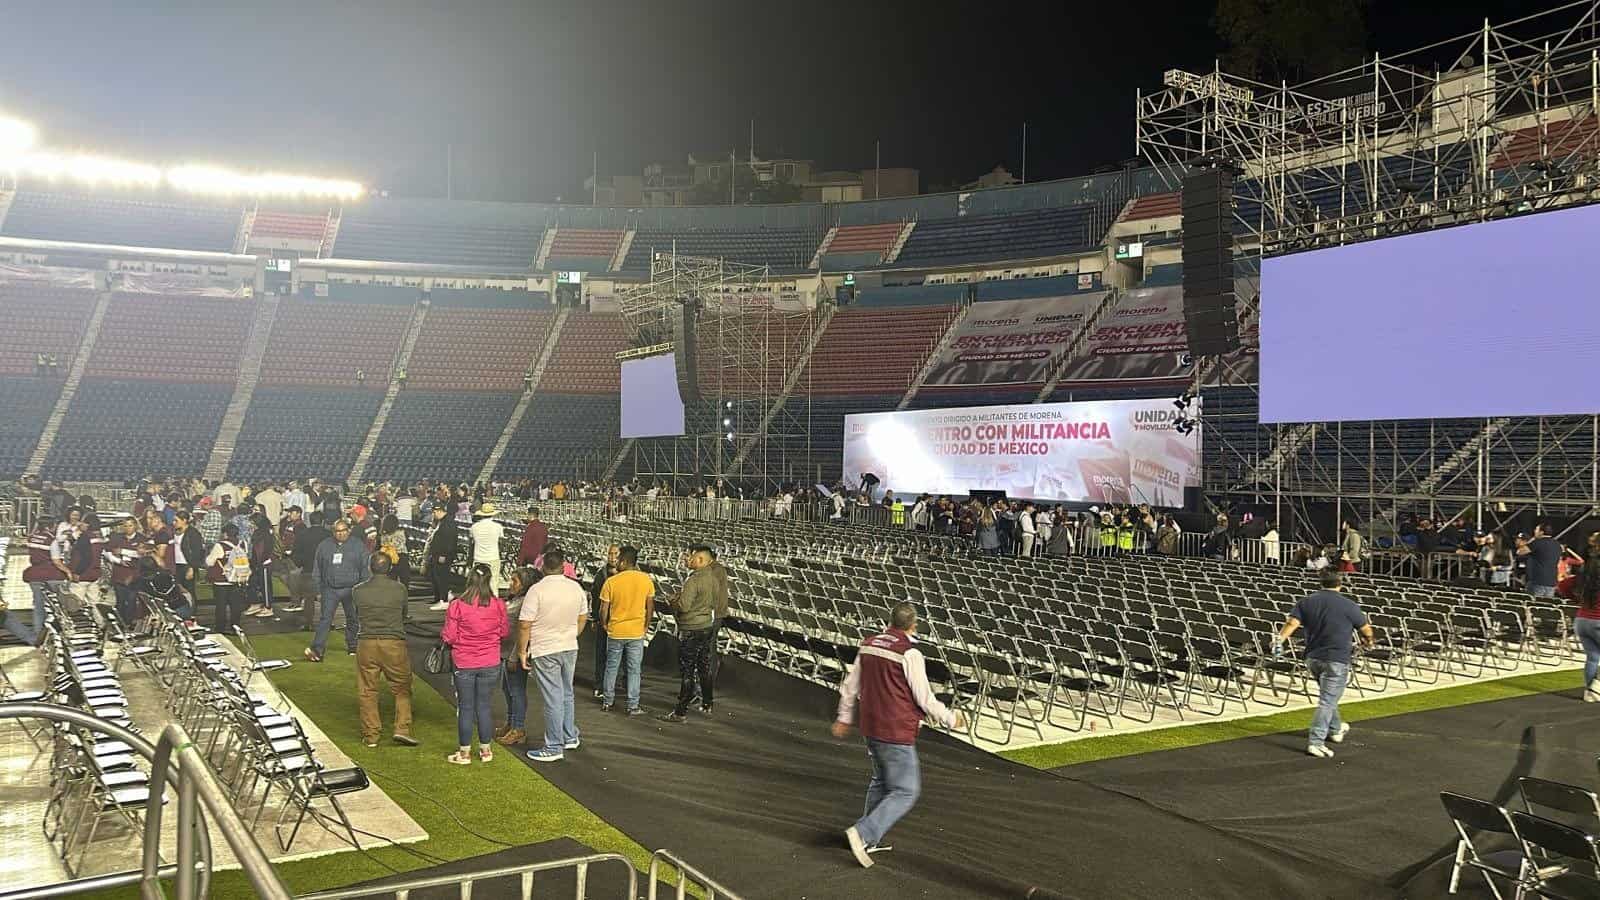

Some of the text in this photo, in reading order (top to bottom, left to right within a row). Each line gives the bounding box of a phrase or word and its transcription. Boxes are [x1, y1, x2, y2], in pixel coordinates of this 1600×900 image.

[558, 271, 568, 279] 10
[1116, 306, 1168, 314] morena
[974, 313, 1083, 326] morena UNIDAD
[1096, 321, 1186, 335] ENCUENT
[1019, 412, 1028, 420] DE
[1029, 411, 1062, 420] MORENA
[975, 424, 1008, 441] CON
[1011, 422, 1111, 440] MILITANCIA
[979, 442, 996, 455] DE
[999, 439, 1049, 455] MÉXICO
[1134, 459, 1180, 485] morena
